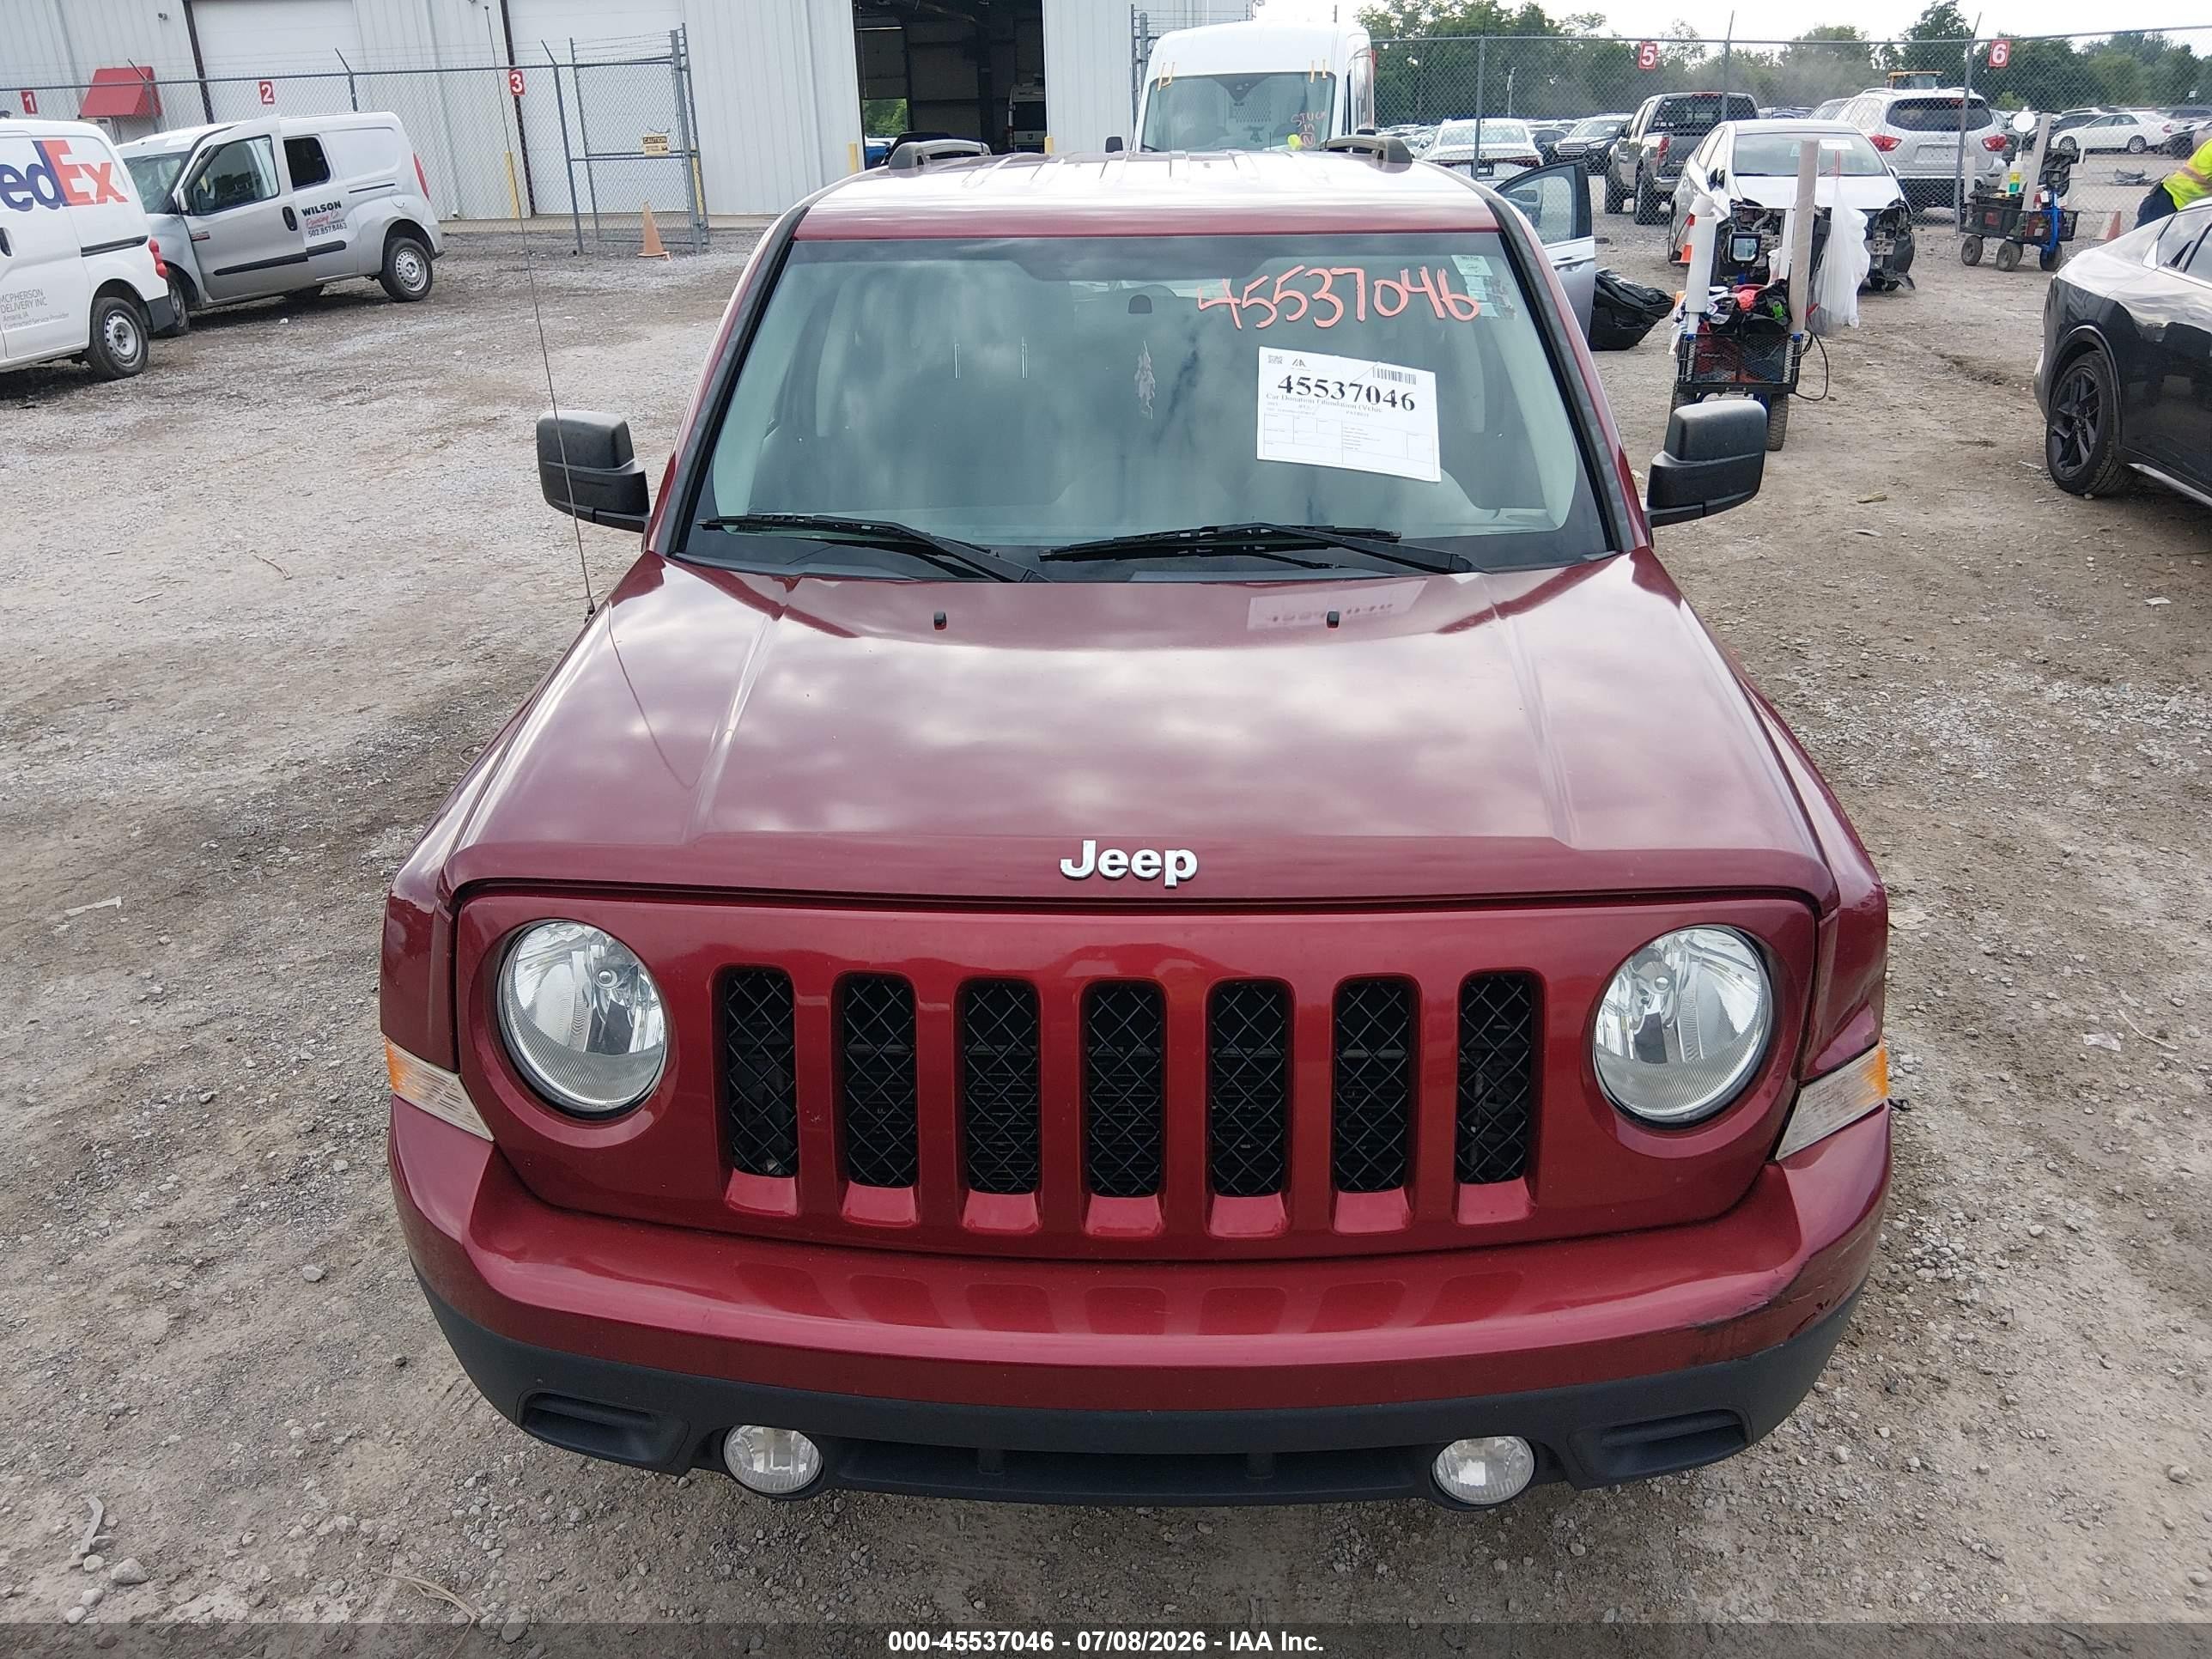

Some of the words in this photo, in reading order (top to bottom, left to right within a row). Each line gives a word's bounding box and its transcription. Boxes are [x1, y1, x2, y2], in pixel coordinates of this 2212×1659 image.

[1641, 46, 1656, 66] 5
[1992, 44, 2007, 64] 6
[261, 83, 273, 102] 2
[511, 74, 523, 93] 3
[25, 94, 35, 112] 1
[301, 200, 342, 216] WILSON
[0, 301, 33, 313] DELIVERY
[35, 296, 47, 307] INC
[1197, 264, 1480, 330] 45537046
[1277, 374, 1416, 412] 45537046
[1060, 839, 1199, 889] Jeep
